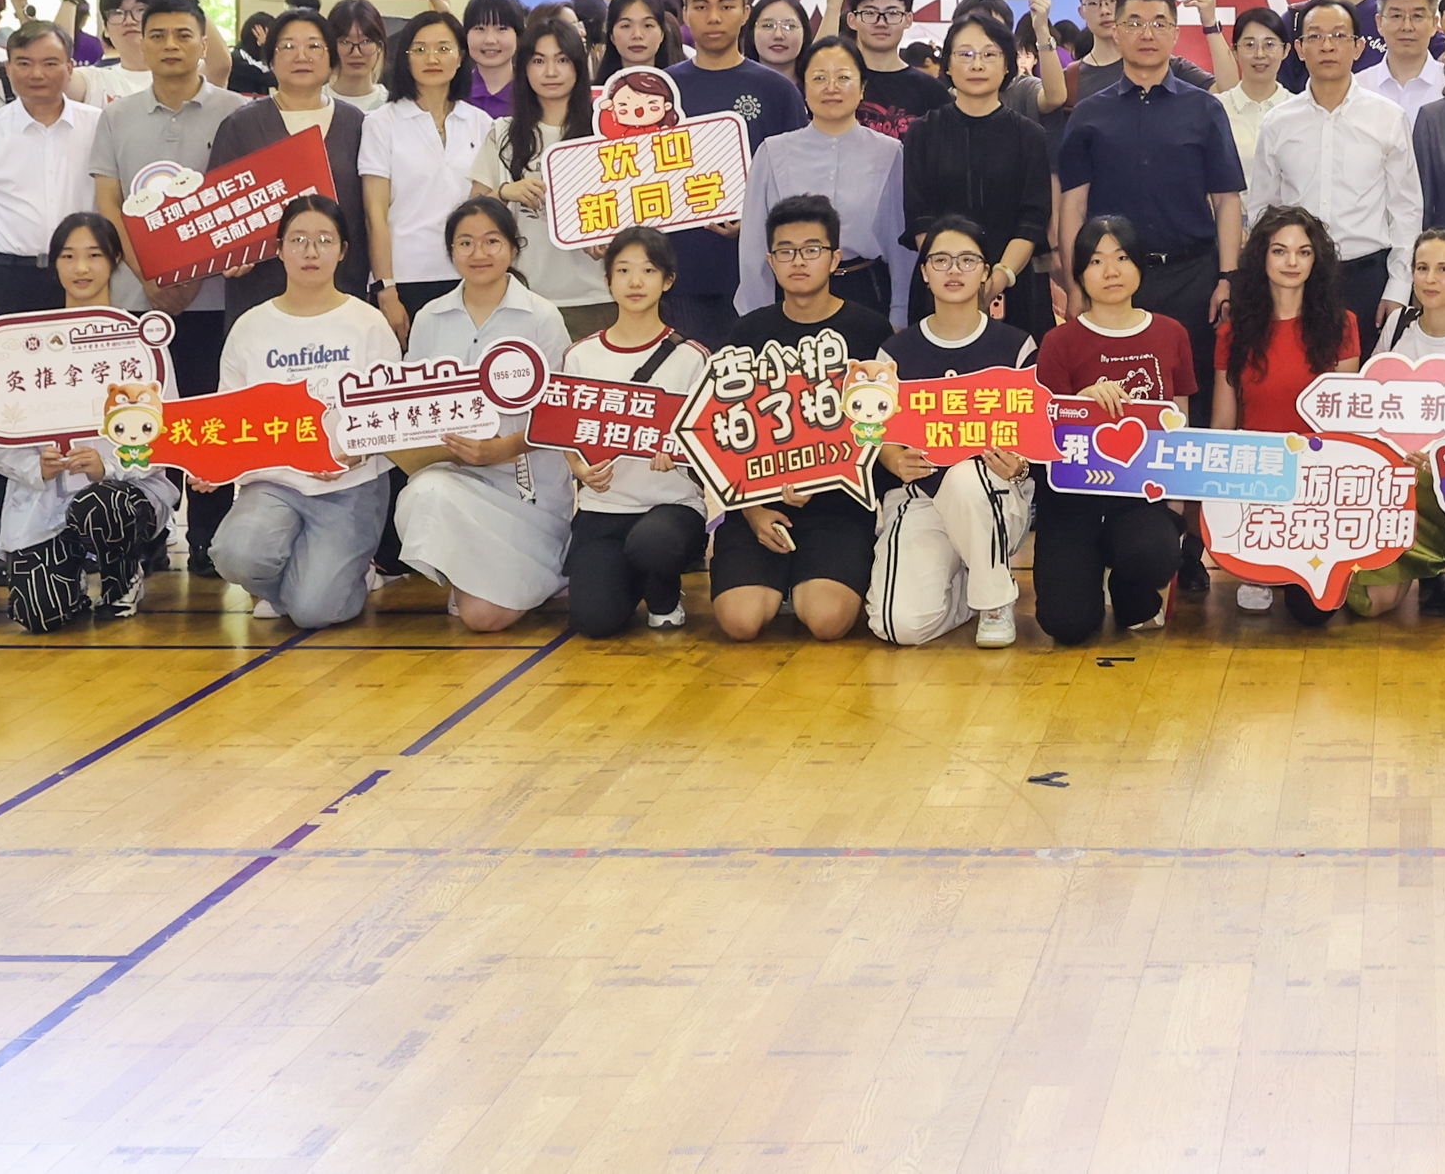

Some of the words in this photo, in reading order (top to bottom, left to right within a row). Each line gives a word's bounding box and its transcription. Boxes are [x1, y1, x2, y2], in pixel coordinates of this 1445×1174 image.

[599, 130, 693, 183] 欢迎
[144, 169, 256, 232] 展现青春作为
[175, 178, 288, 243] 彰显青春风采
[577, 171, 725, 234] 新同学
[266, 344, 350, 369] Confident
[493, 368, 531, 380] 1956-2026
[712, 334, 848, 399] 杏小护
[543, 381, 657, 420] 志存高远
[712, 380, 844, 452] 拍了拍
[909, 387, 1034, 417] 中医学院
[1315, 391, 1405, 421] 新起点
[167, 416, 319, 447] 我爱上中医
[347, 433, 398, 450] 建校70周年
[572, 417, 686, 458] 勇担使命
[925, 420, 1019, 448] 欢迎您
[1062, 433, 1089, 465] 我
[1146, 439, 1285, 478] 上中医康复
[1244, 508, 1416, 551] 未来可期
